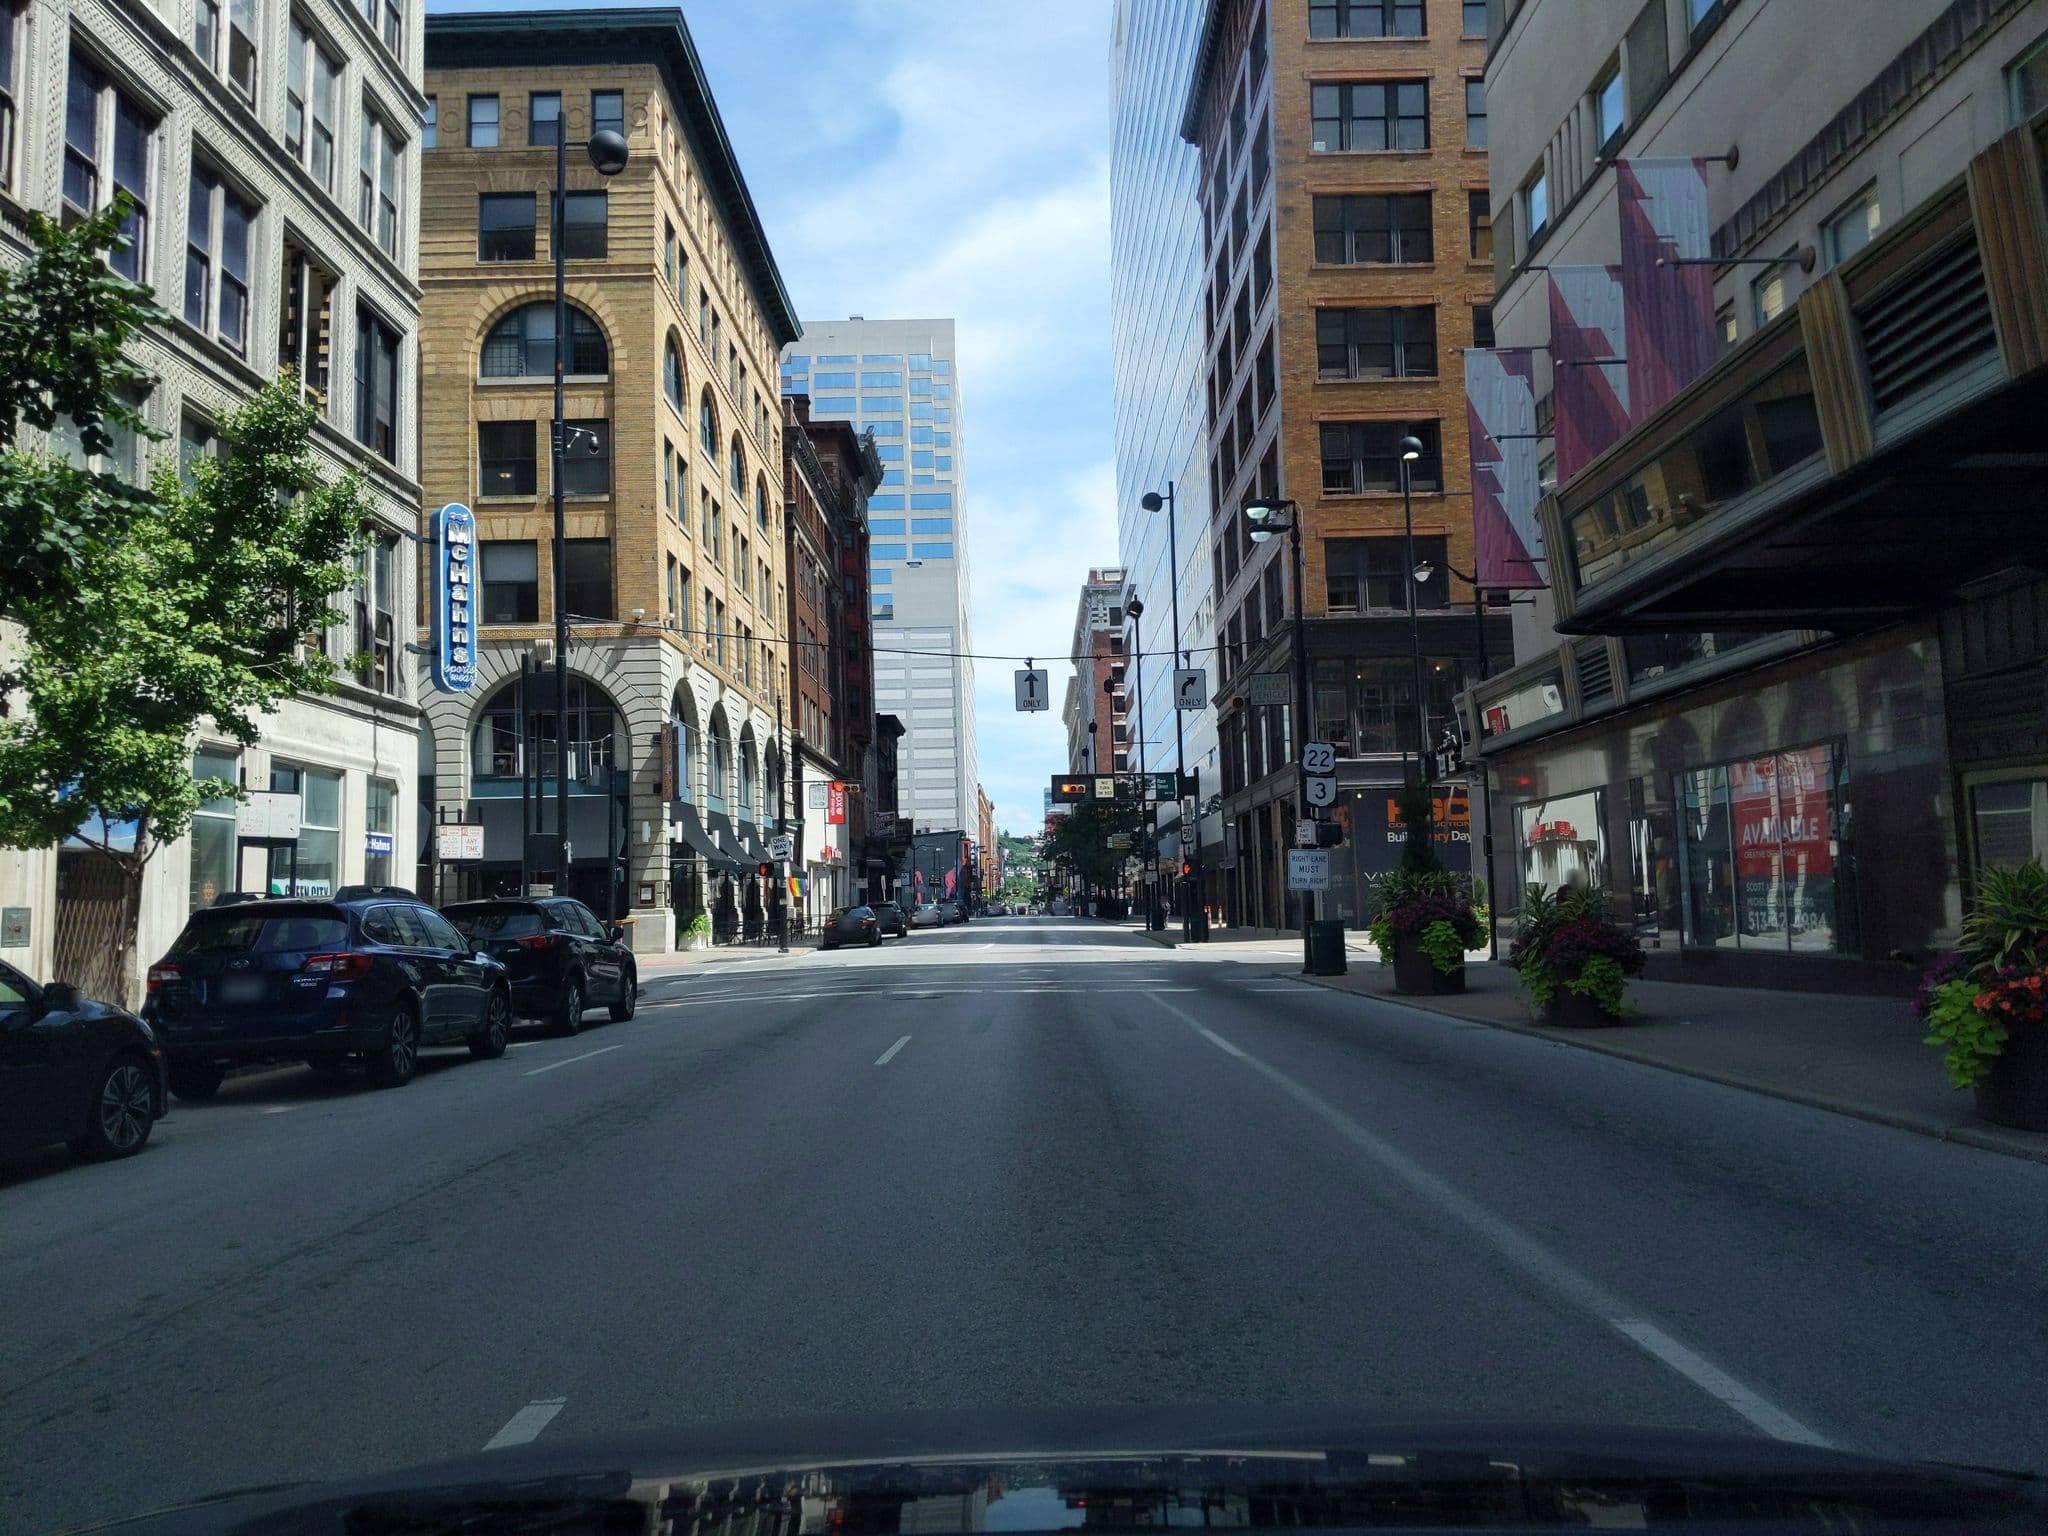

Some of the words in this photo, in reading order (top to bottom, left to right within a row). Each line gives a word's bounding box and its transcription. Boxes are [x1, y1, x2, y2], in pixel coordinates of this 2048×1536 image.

[1022, 700, 1041, 708] ONLY
[1179, 699, 1201, 707] ONLY
[1308, 750, 1330, 767] 22
[1315, 782, 1326, 800] 3
[1743, 817, 1819, 845] AVAILABLE
[465, 845, 478, 853] TIME
[1299, 865, 1320, 873] MUST
